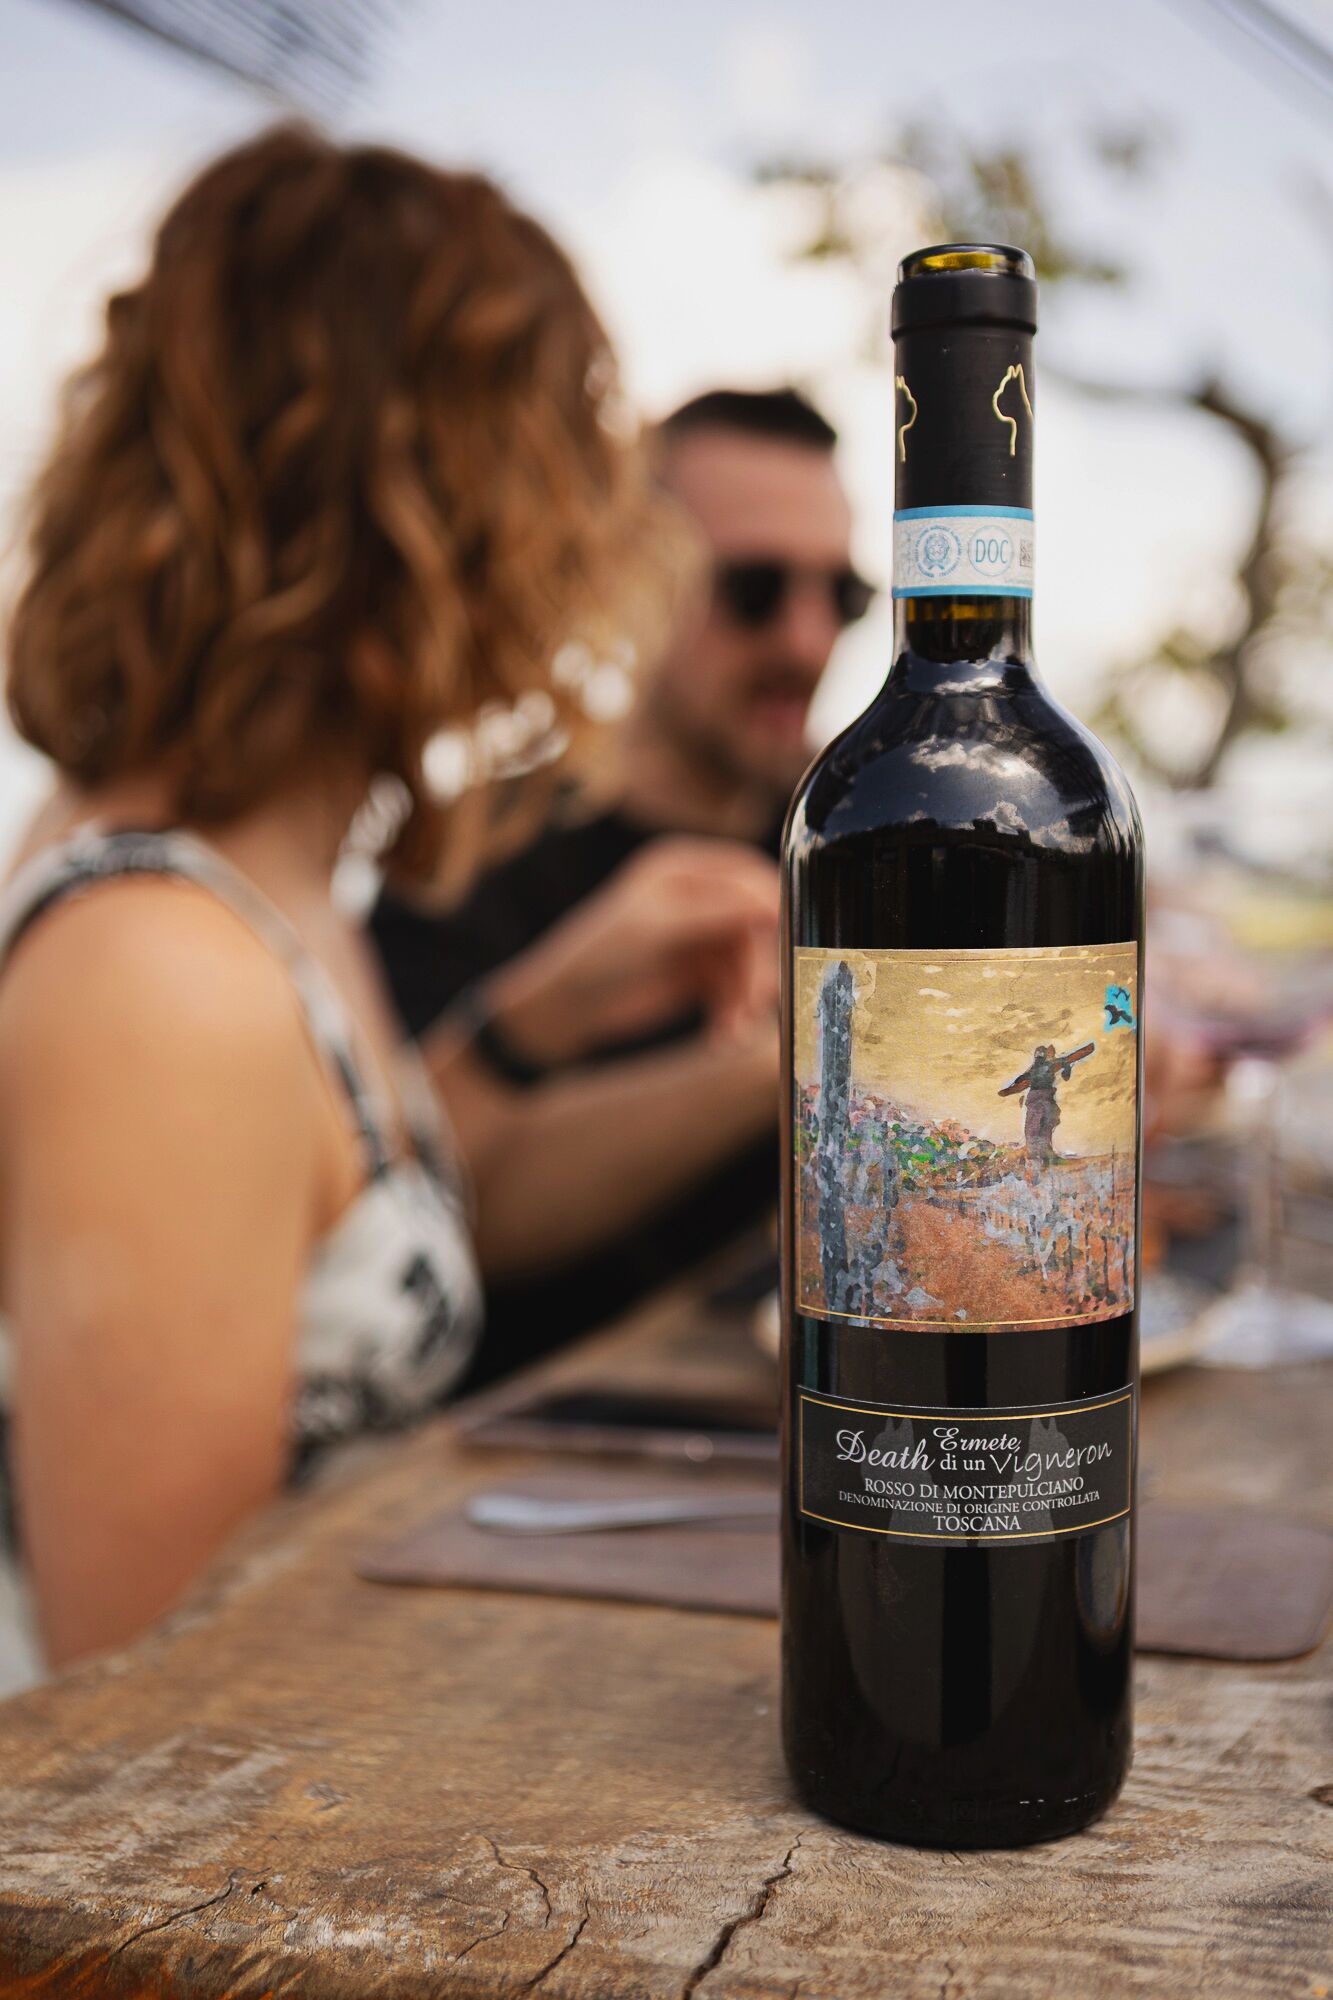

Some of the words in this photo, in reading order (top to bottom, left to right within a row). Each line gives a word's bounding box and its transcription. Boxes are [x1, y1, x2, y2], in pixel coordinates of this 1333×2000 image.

[975, 538, 1009, 564] DOC
[932, 1427, 1022, 1451] Ermete
[836, 1429, 936, 1471] Death
[940, 1453, 958, 1471] di
[963, 1459, 986, 1471] un
[989, 1442, 1113, 1482] Vigneron
[864, 1477, 915, 1497] ROSSO
[919, 1484, 939, 1499] DI
[943, 1476, 1084, 1500] MONTEPULCIANO
[838, 1490, 944, 1514] DENOMINAZIONE
[946, 1503, 961, 1514] DI
[964, 1502, 1020, 1514] ORIGINE
[1022, 1490, 1100, 1512] CONTROLLATA
[932, 1515, 1022, 1532] TOSCANA
